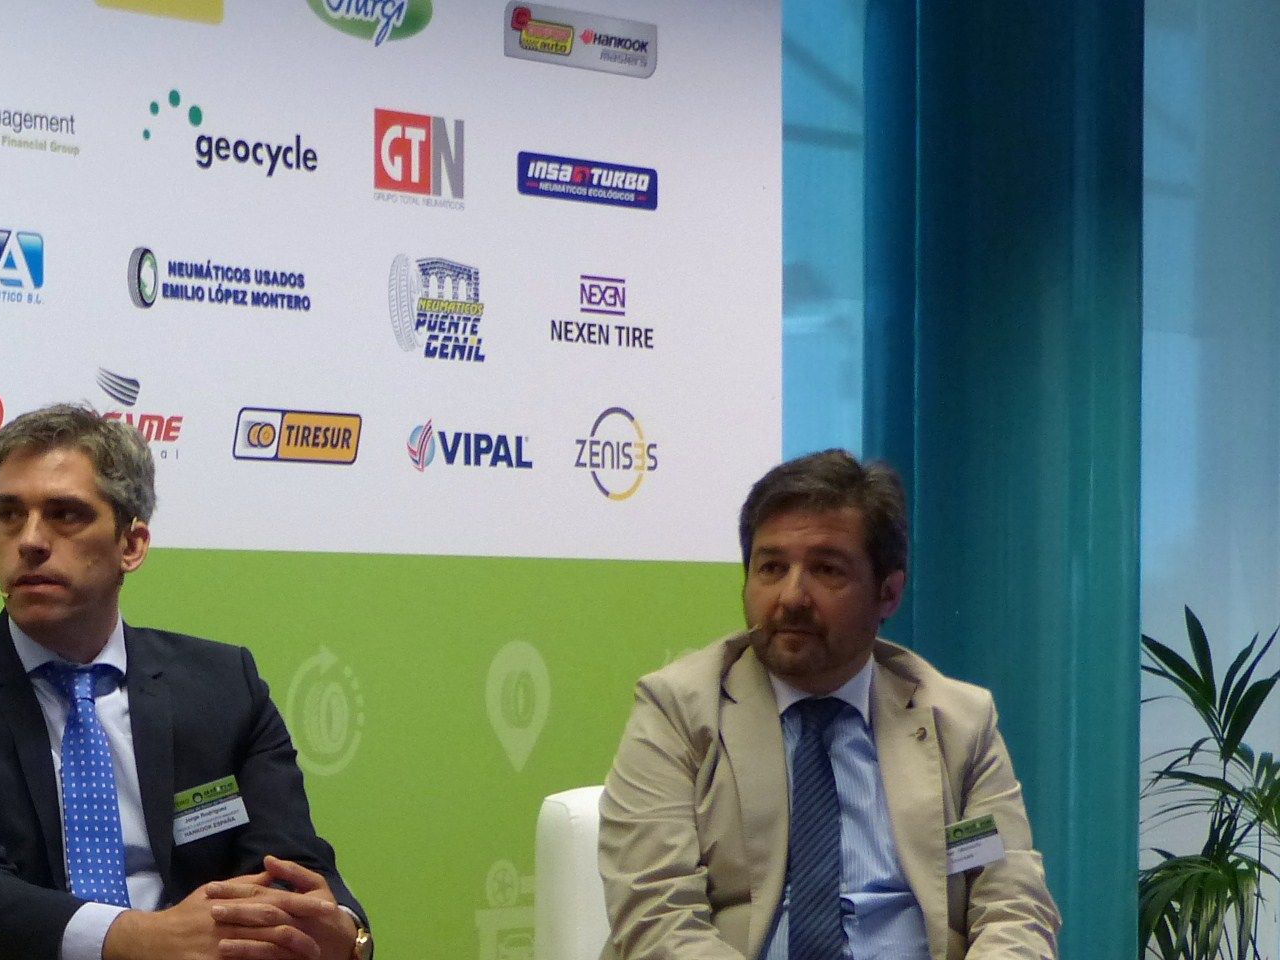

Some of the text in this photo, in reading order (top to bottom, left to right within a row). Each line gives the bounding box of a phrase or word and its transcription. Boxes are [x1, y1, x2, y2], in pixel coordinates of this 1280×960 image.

[195, 134, 318, 177] geocycle
[380, 116, 464, 199] GTN
[168, 260, 305, 289] NEUMÁTICOS USADOS
[162, 283, 311, 312] EMILIO LÓPEZ MONTERO
[415, 313, 481, 335] PUENTE
[551, 320, 654, 349] NEXEN TIRE
[286, 425, 352, 449] TIRESUR
[438, 431, 533, 469] VIPAL
